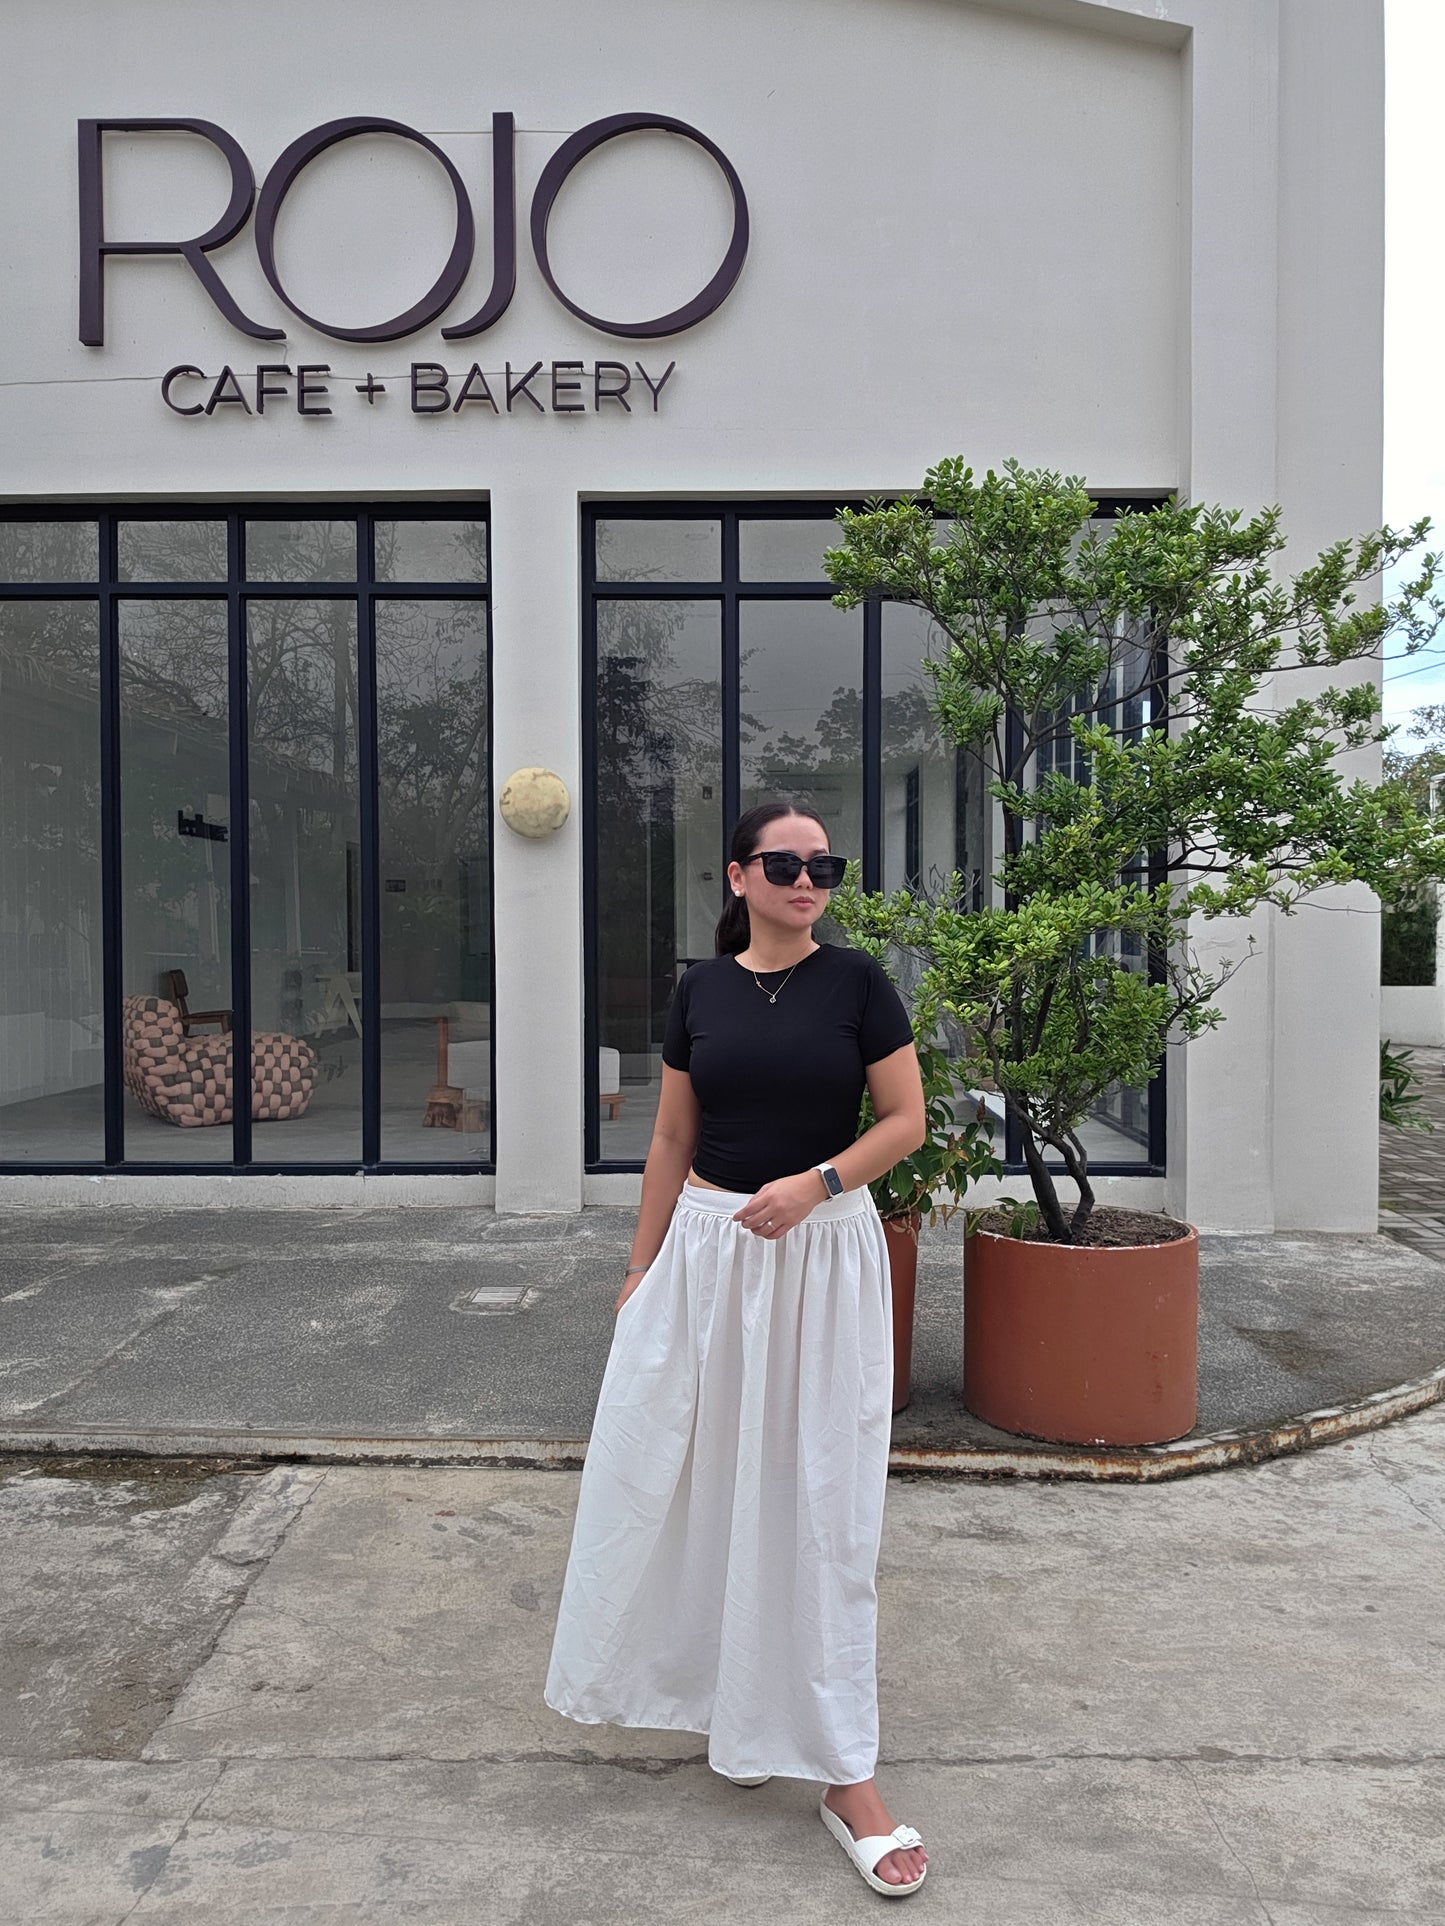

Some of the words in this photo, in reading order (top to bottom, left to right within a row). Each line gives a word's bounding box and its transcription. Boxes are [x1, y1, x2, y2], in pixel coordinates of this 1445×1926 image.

[78, 112, 749, 346] ROJO
[161, 364, 333, 415] CAFE
[355, 372, 386, 405] +
[410, 361, 676, 414] BAKERY
